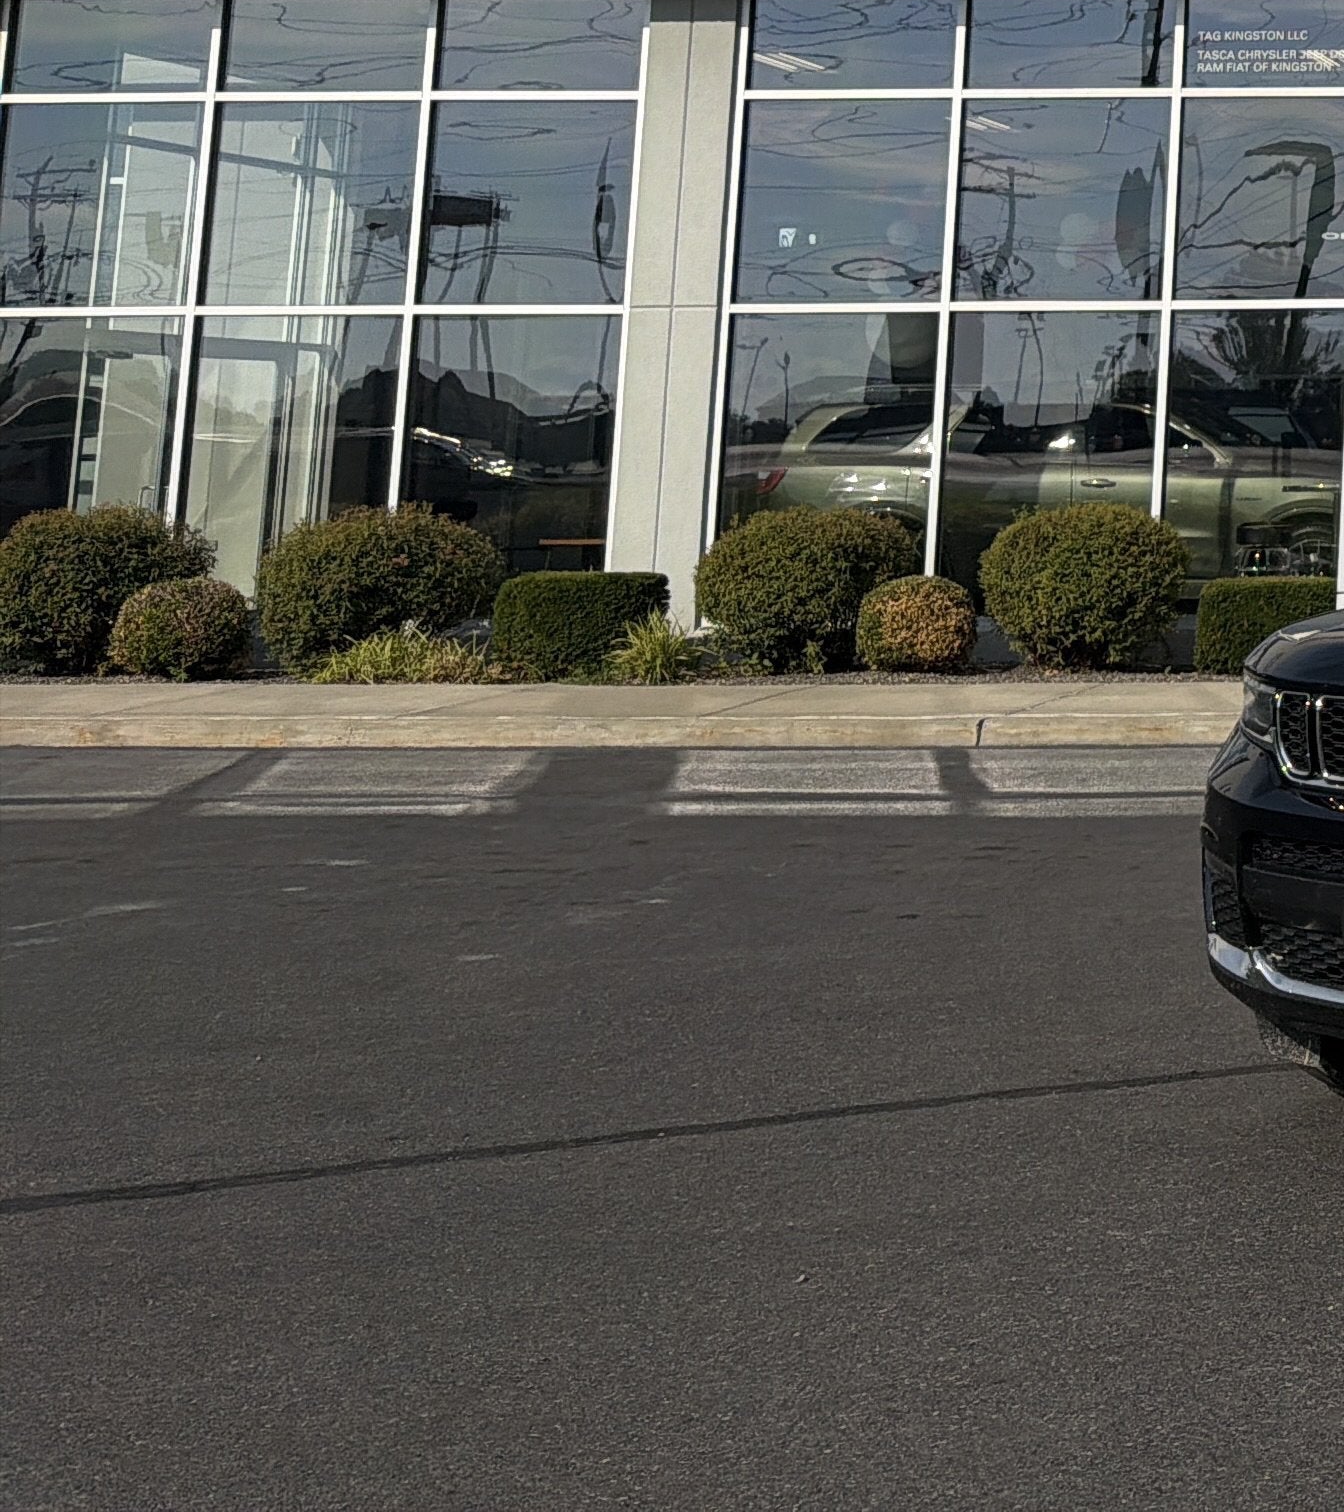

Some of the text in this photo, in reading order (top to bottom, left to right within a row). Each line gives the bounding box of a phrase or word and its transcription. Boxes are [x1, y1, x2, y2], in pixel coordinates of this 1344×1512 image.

[1198, 29, 1309, 41] TAG KINGSTON LLC
[1197, 49, 1236, 60] TASCA
[1237, 49, 1297, 60] CHRYSLER
[1196, 62, 1224, 72] RAM
[1226, 61, 1251, 72] FIAT
[1253, 61, 1269, 72] OF
